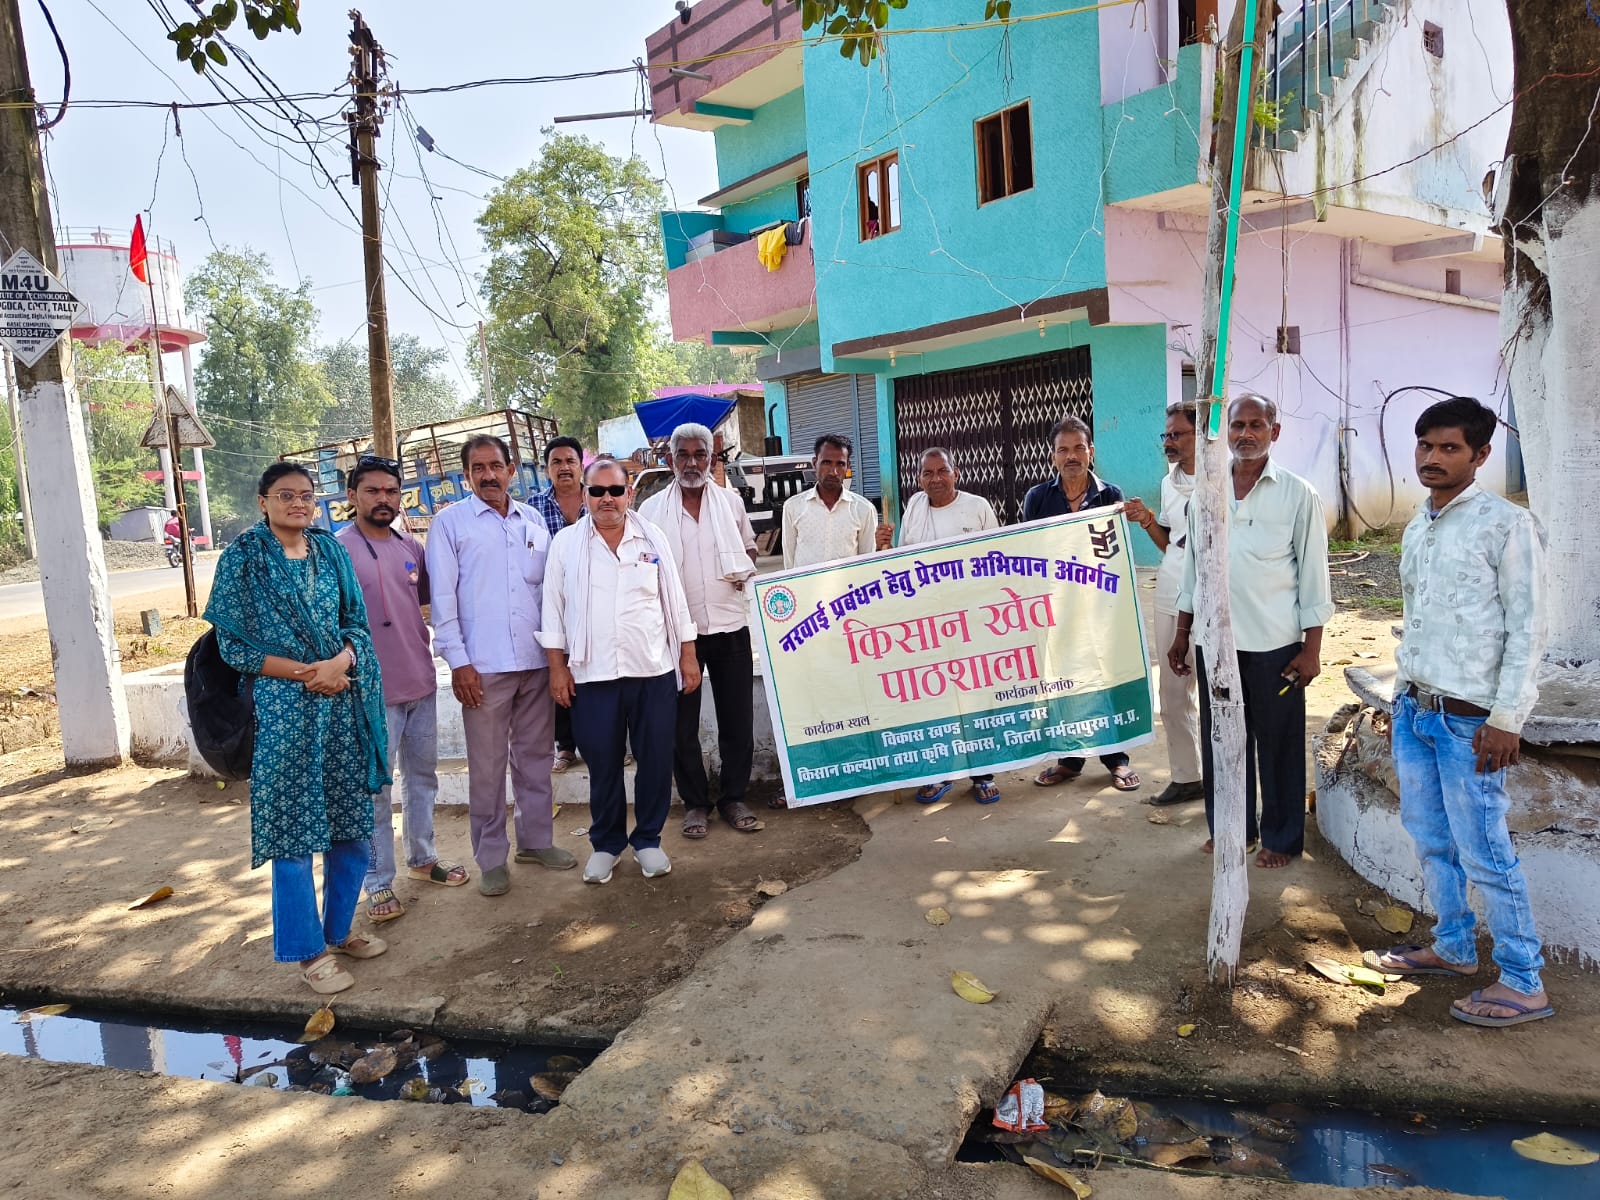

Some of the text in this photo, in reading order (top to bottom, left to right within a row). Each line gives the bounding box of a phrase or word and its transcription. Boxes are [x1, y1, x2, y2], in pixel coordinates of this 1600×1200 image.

[2, 275, 49, 291] M4U
[0, 301, 26, 312] GDCA,
[52, 303, 78, 312] TALLY
[778, 550, 1121, 653] नरवाई प्रबंधन हेतु प्रेरणा अभियान अंतर्गत
[842, 586, 1057, 664] किसान खेत
[877, 645, 1040, 703] पाठशाला
[995, 684, 1038, 702] कार्यक्रम
[1041, 677, 1075, 695] दिनांक
[803, 719, 845, 737] कार्यक्रम
[847, 715, 871, 729] स्थल
[881, 729, 924, 747] विकास
[927, 721, 961, 740] खण्ड
[972, 711, 1016, 730] माखन
[1017, 706, 1049, 721] नगर
[796, 764, 840, 783] किसान
[841, 754, 891, 775] कल्याण
[892, 749, 919, 766] तथा
[920, 742, 950, 764] कृषि
[951, 737, 1000, 756] विकास,
[1003, 728, 1042, 747] जिला
[1044, 714, 1110, 738] नर्मदापुरम
